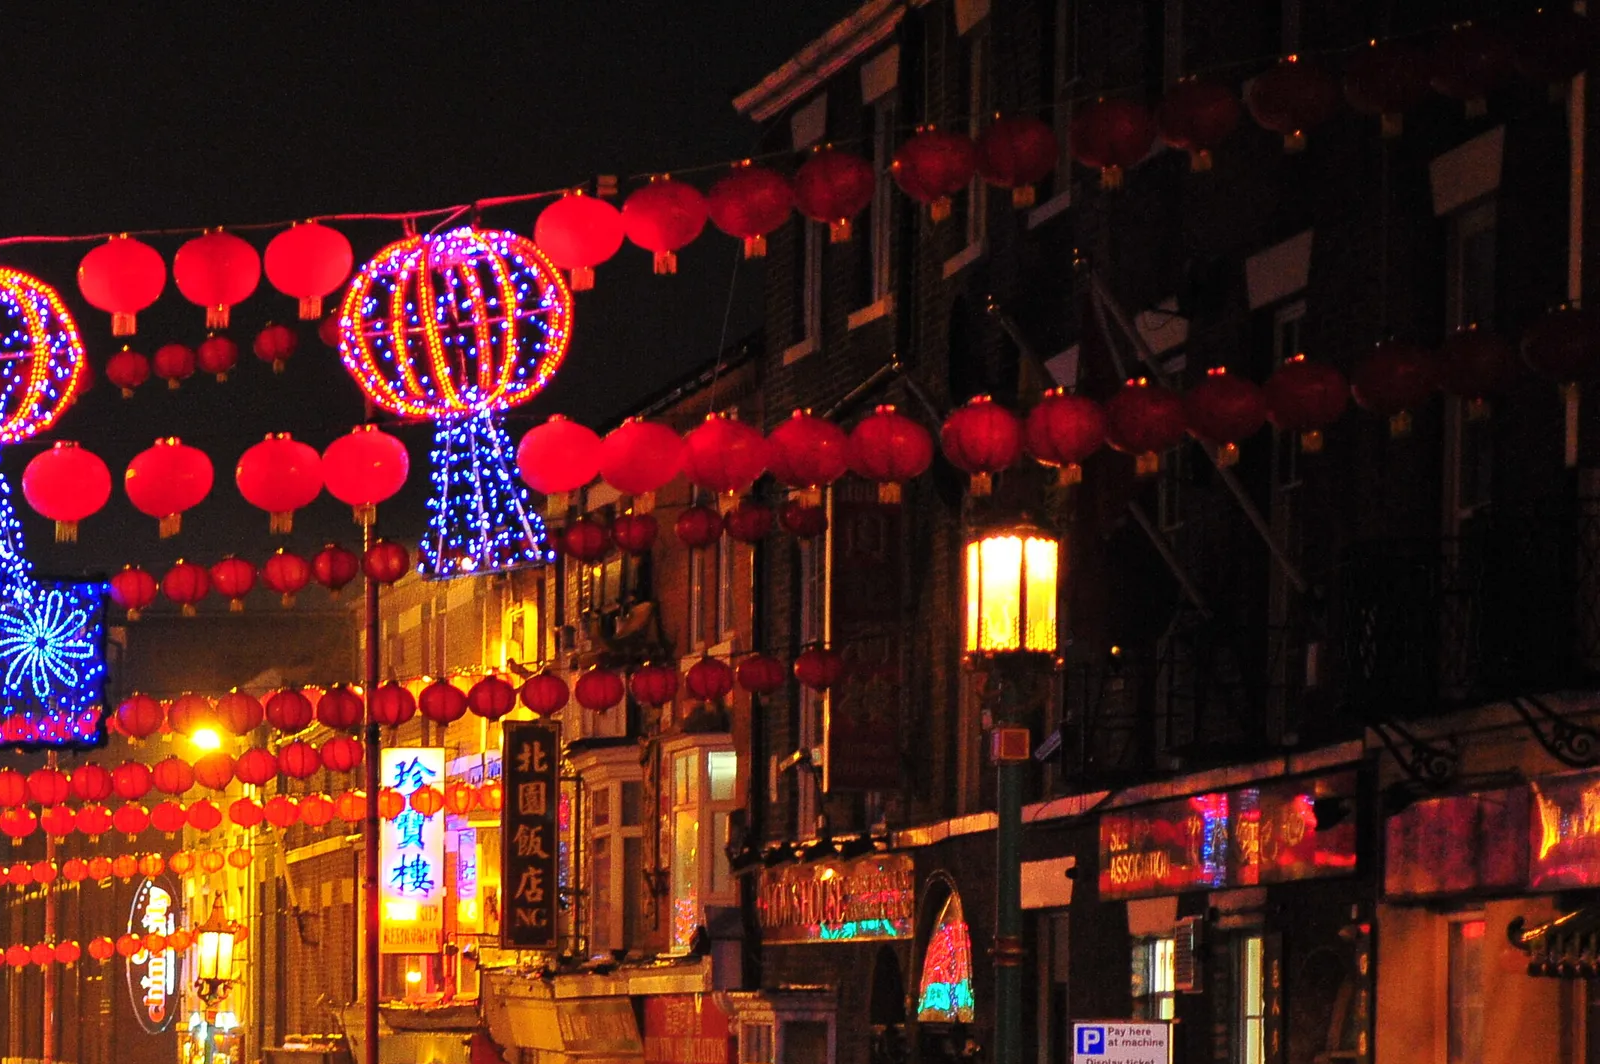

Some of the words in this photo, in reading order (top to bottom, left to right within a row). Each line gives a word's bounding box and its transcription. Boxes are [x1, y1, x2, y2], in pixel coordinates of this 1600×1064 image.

[512, 739, 550, 903] 北園飯店
[1110, 850, 1170, 885] ASSOCIATION
[515, 907, 549, 928] NG
[1108, 1027, 1126, 1037] Pay
[1129, 1027, 1151, 1036] here
[1108, 1038, 1119, 1047] at
[1122, 1037, 1164, 1047] machine
